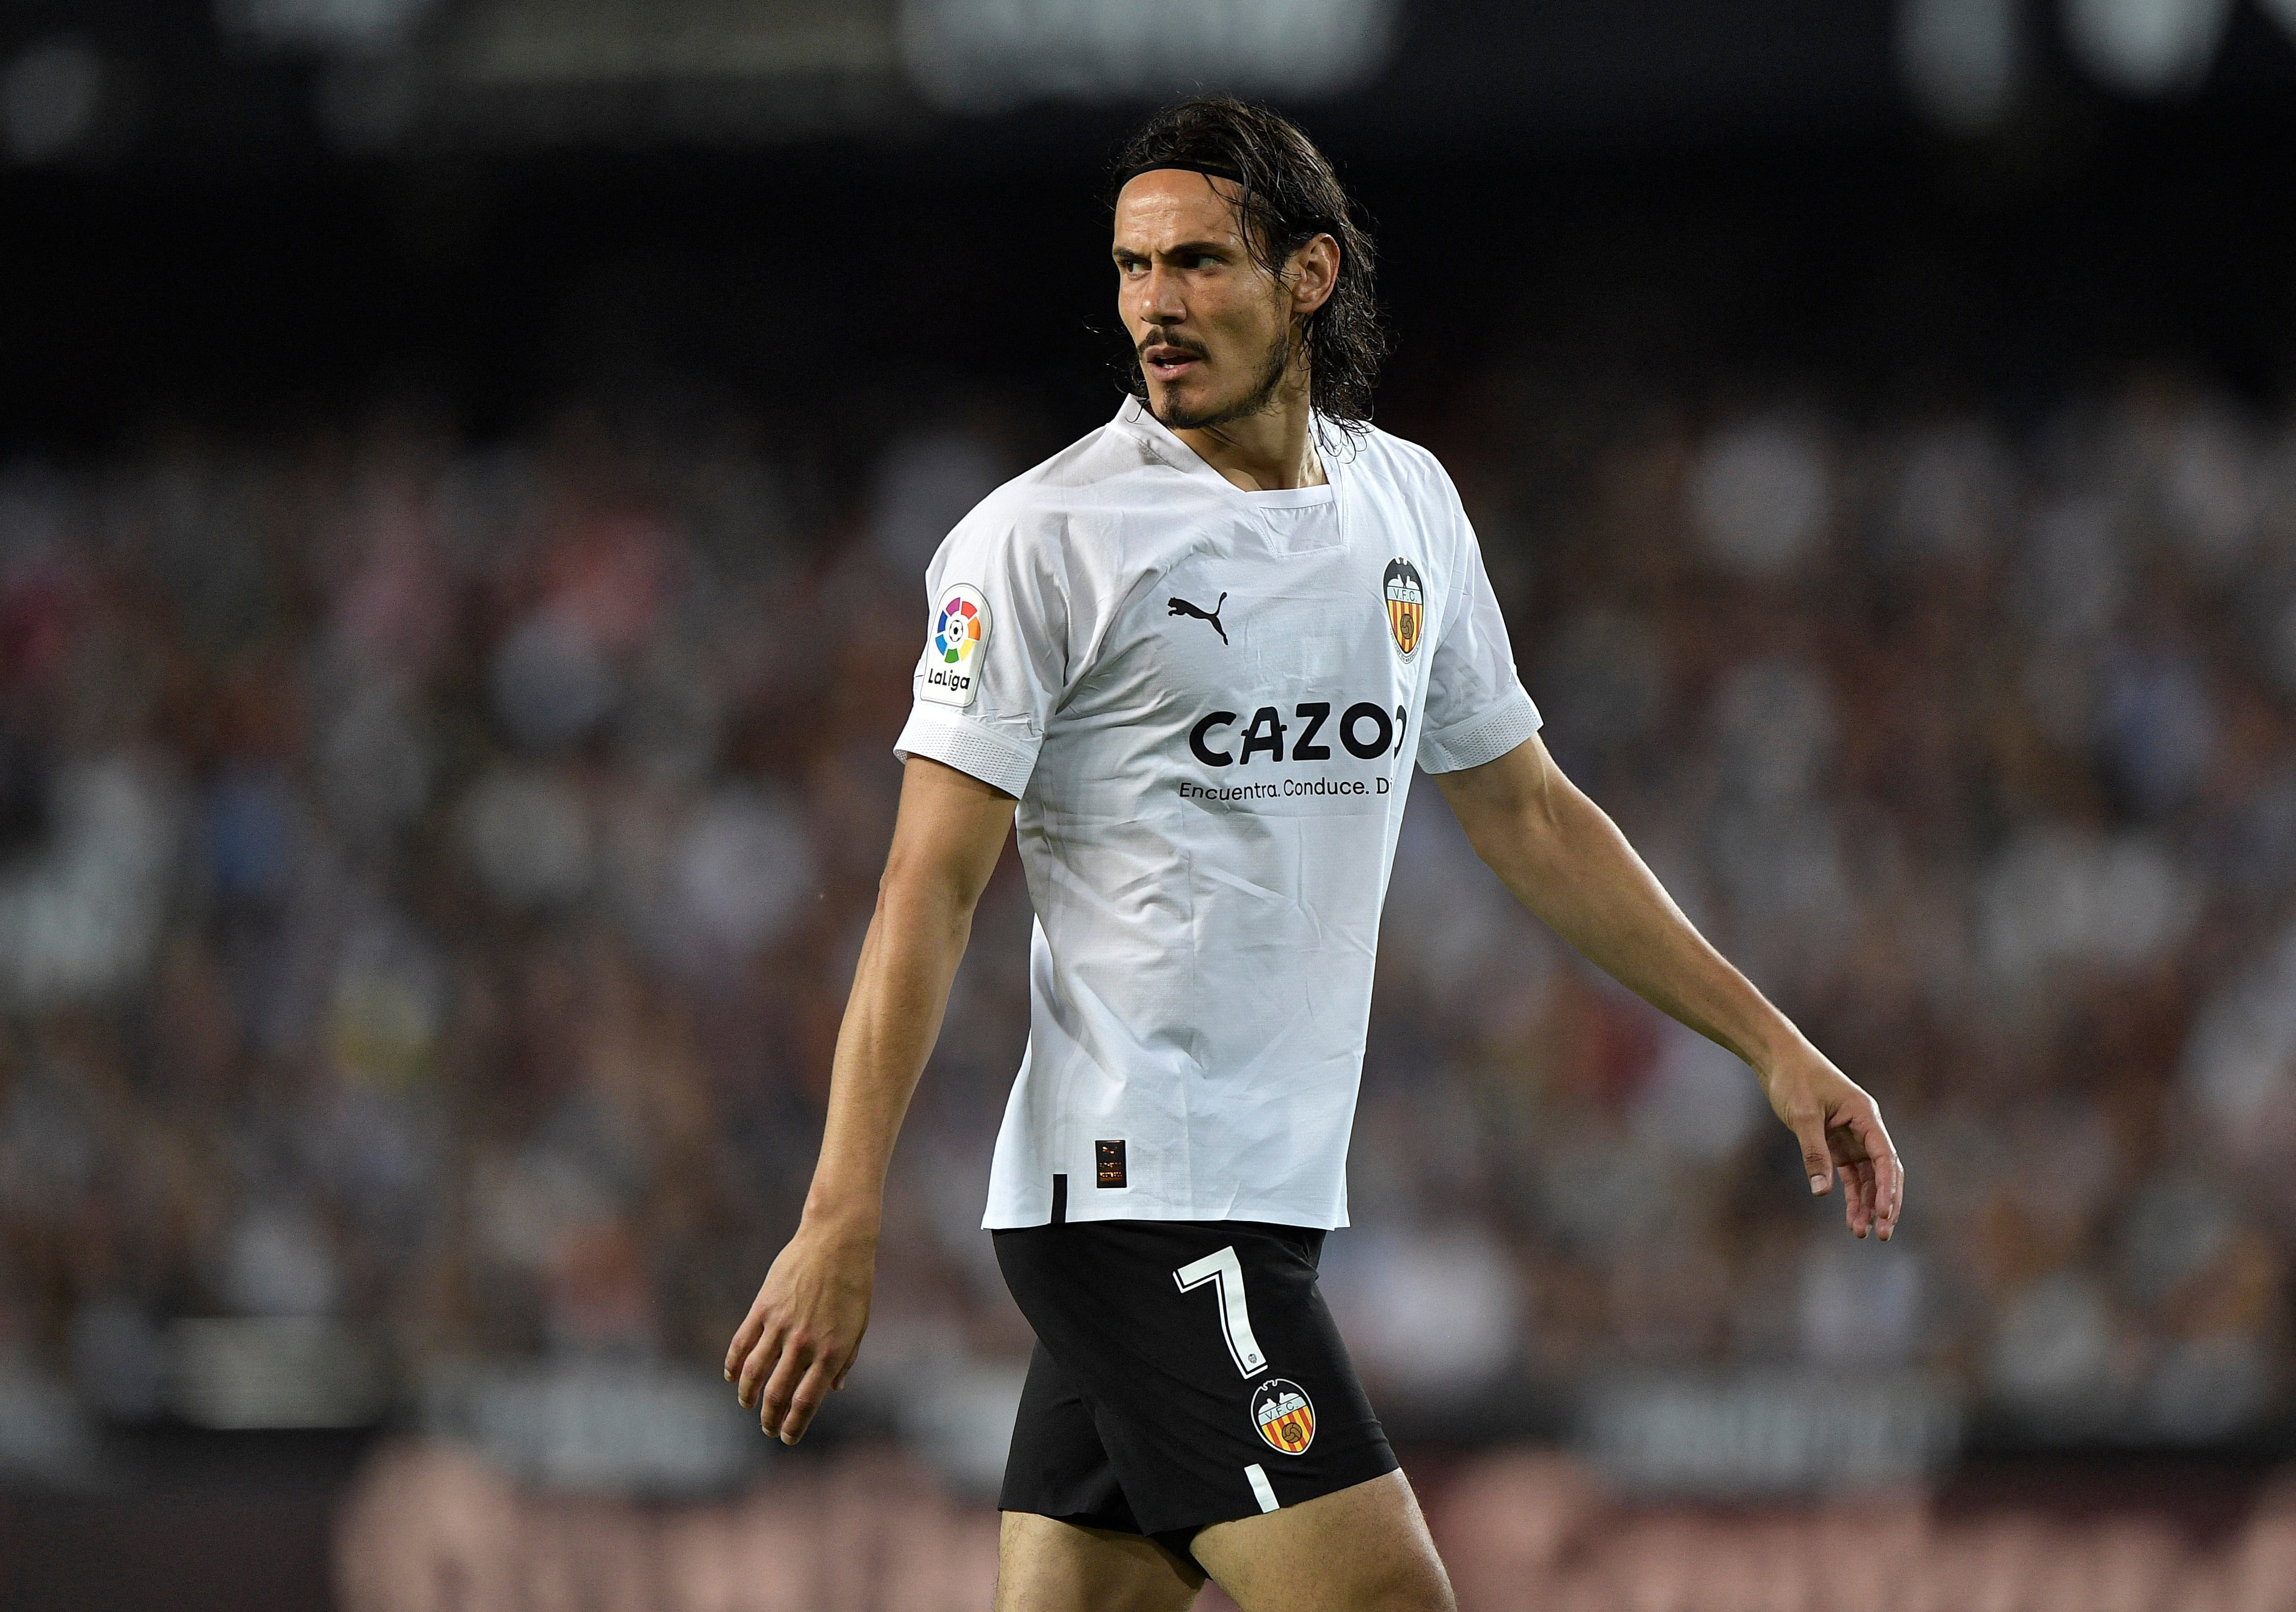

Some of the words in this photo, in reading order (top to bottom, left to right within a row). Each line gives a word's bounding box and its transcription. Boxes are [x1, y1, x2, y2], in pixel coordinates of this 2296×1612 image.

[1393, 588, 1418, 602] V.F.C.
[928, 668, 971, 691] LaLiga
[1179, 782, 1281, 801] Encuentra.
[1283, 777, 1370, 797] Conduce.
[1172, 1245, 1268, 1380] 7
[1265, 1402, 1299, 1420] V.F.C.
